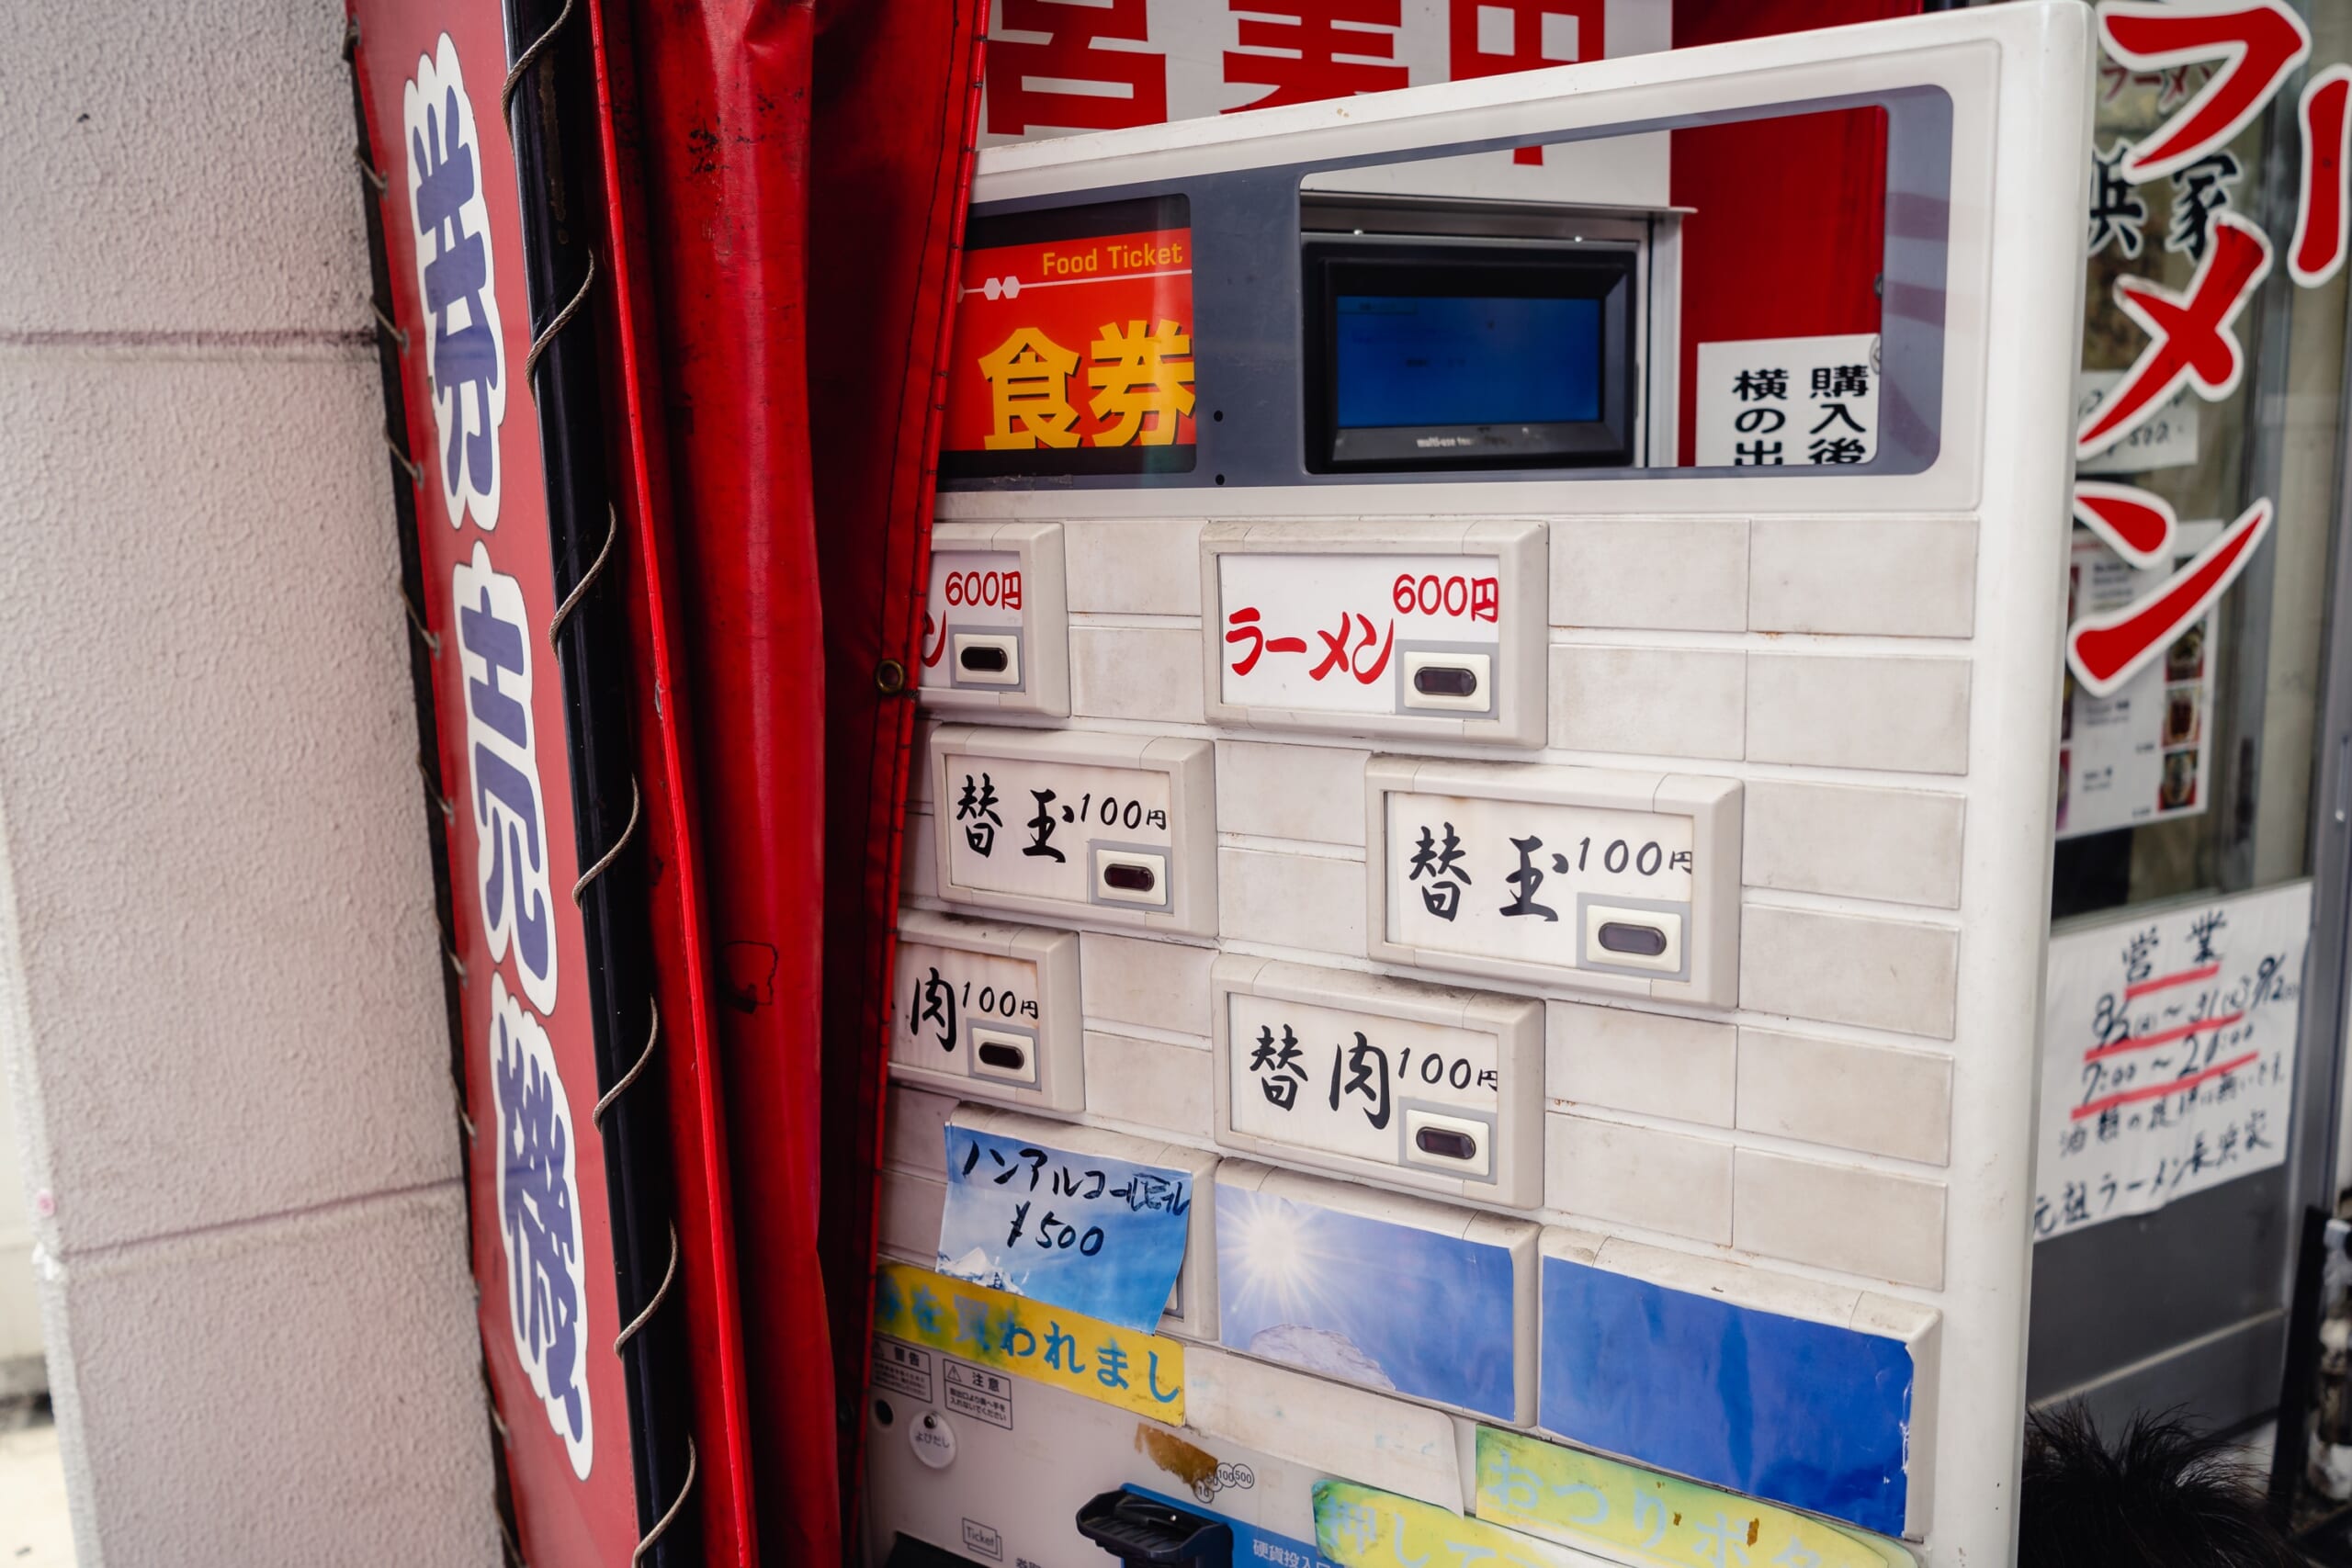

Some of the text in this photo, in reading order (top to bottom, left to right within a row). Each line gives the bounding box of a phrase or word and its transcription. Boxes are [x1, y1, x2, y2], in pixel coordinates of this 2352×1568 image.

[1043, 242, 1183, 275] Food Ticket
[978, 318, 1195, 449] 食券
[945, 571, 1023, 611] 600円
[1392, 574, 1499, 623] 600円
[1226, 607, 1394, 685] ラーメン
[956, 773, 1168, 863] 替玉 100円
[1408, 821, 1692, 923] 替玉 100円
[961, 982, 1039, 1021] 100円
[1249, 1024, 1498, 1131] 替肉 100円
[972, 1371, 1001, 1393] 注意
[914, 1431, 950, 1449] よびだし
[1235, 1470, 1252, 1484] 500
[967, 1526, 996, 1548] Ticket
